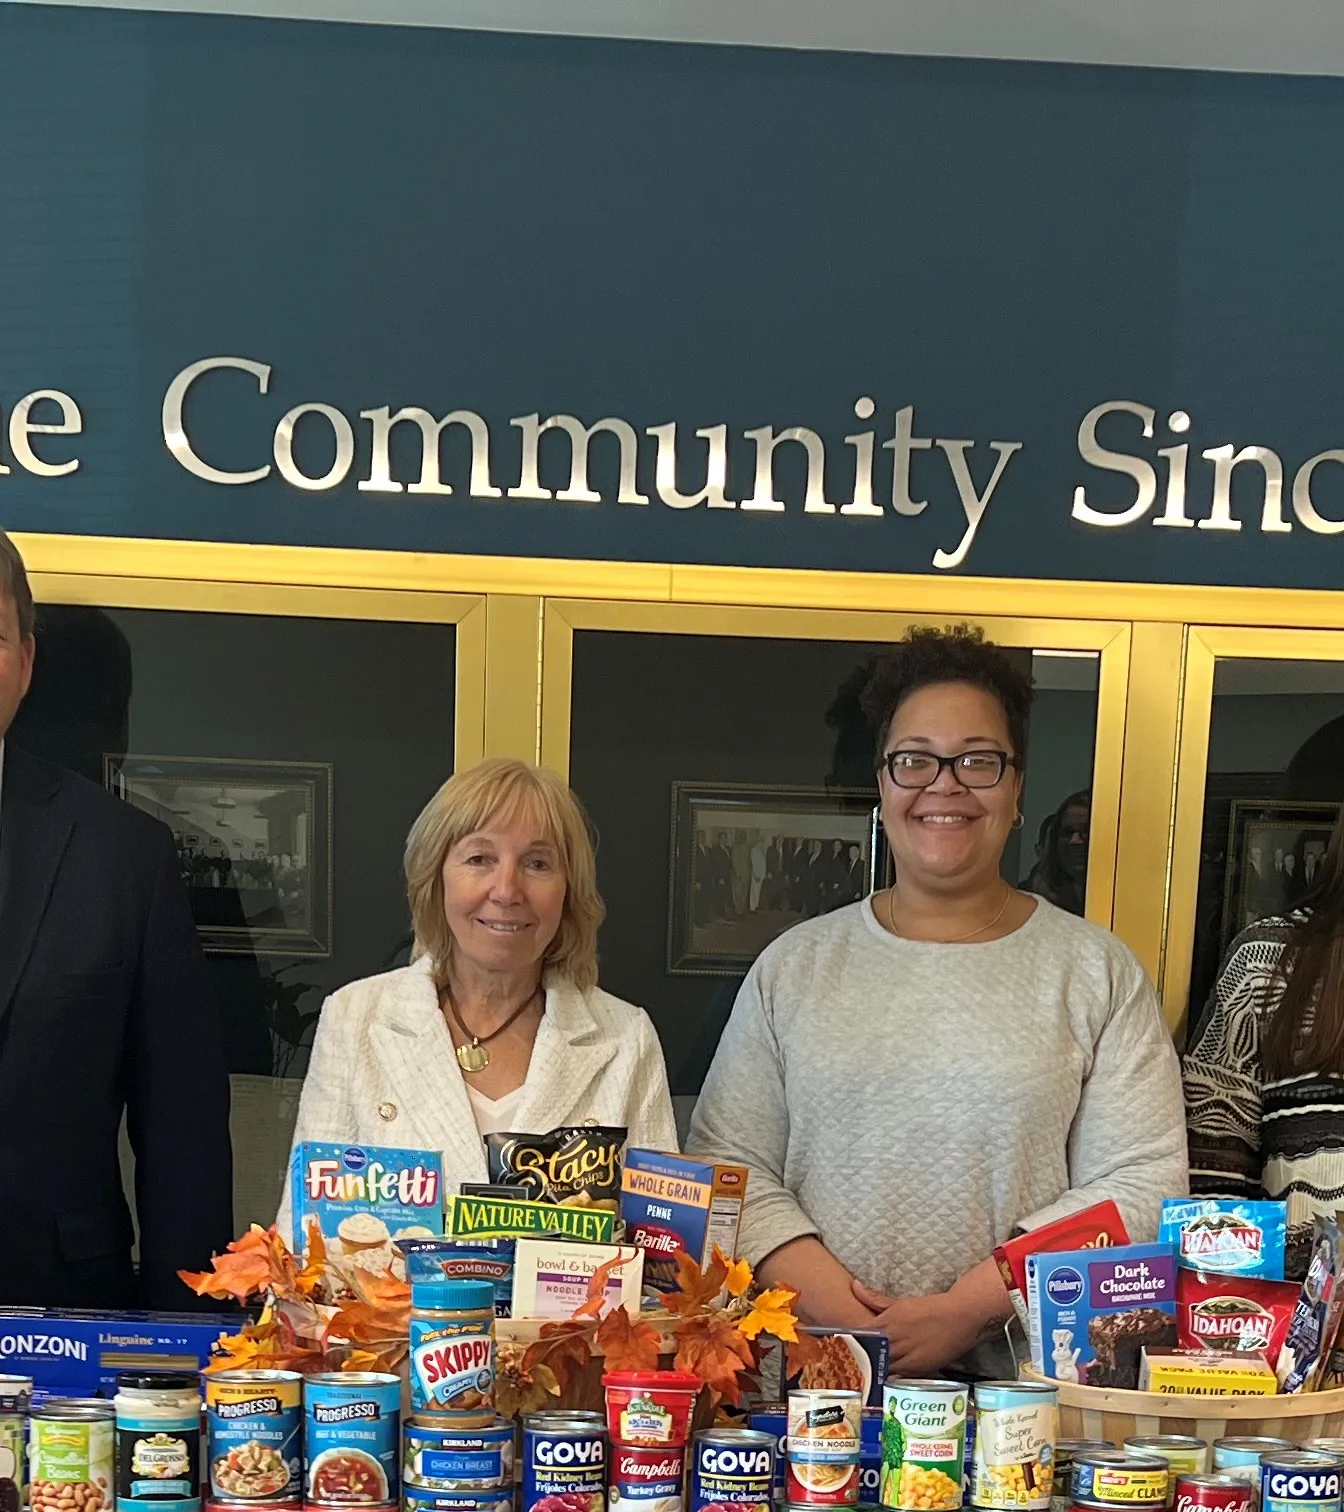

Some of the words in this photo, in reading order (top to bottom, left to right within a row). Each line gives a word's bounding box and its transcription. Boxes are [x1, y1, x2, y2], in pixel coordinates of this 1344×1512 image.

[161, 355, 1022, 569] Community
[305, 1157, 439, 1208] Funfetti
[572, 1171, 605, 1191] Chips
[629, 1172, 665, 1196] WHOLE
[666, 1179, 702, 1203] GRAIN
[457, 1201, 536, 1232] NATURE
[539, 1210, 609, 1243] VALLEY
[646, 1203, 672, 1221] PENNE
[633, 1228, 681, 1254] Barilla
[446, 1264, 505, 1276] COMBINO
[536, 1258, 566, 1271] bowl
[1113, 1263, 1150, 1279] Dark
[545, 1285, 582, 1296] NOODLE
[1047, 1279, 1083, 1294] Pillsbury
[1099, 1274, 1166, 1294] Chocolate
[1192, 1315, 1270, 1334] IDAHOAN
[98, 1333, 155, 1347] Linguine
[422, 1340, 490, 1384] SKIPPY
[217, 1398, 278, 1419] PROGRESSO
[315, 1402, 376, 1423] PROGRESSO
[899, 1397, 947, 1412] Green
[904, 1411, 948, 1427] Giant
[535, 1440, 604, 1465] GOYA
[701, 1448, 771, 1474] GOYA
[620, 1456, 682, 1480] Campbell's
[1270, 1474, 1340, 1498] GOYA
